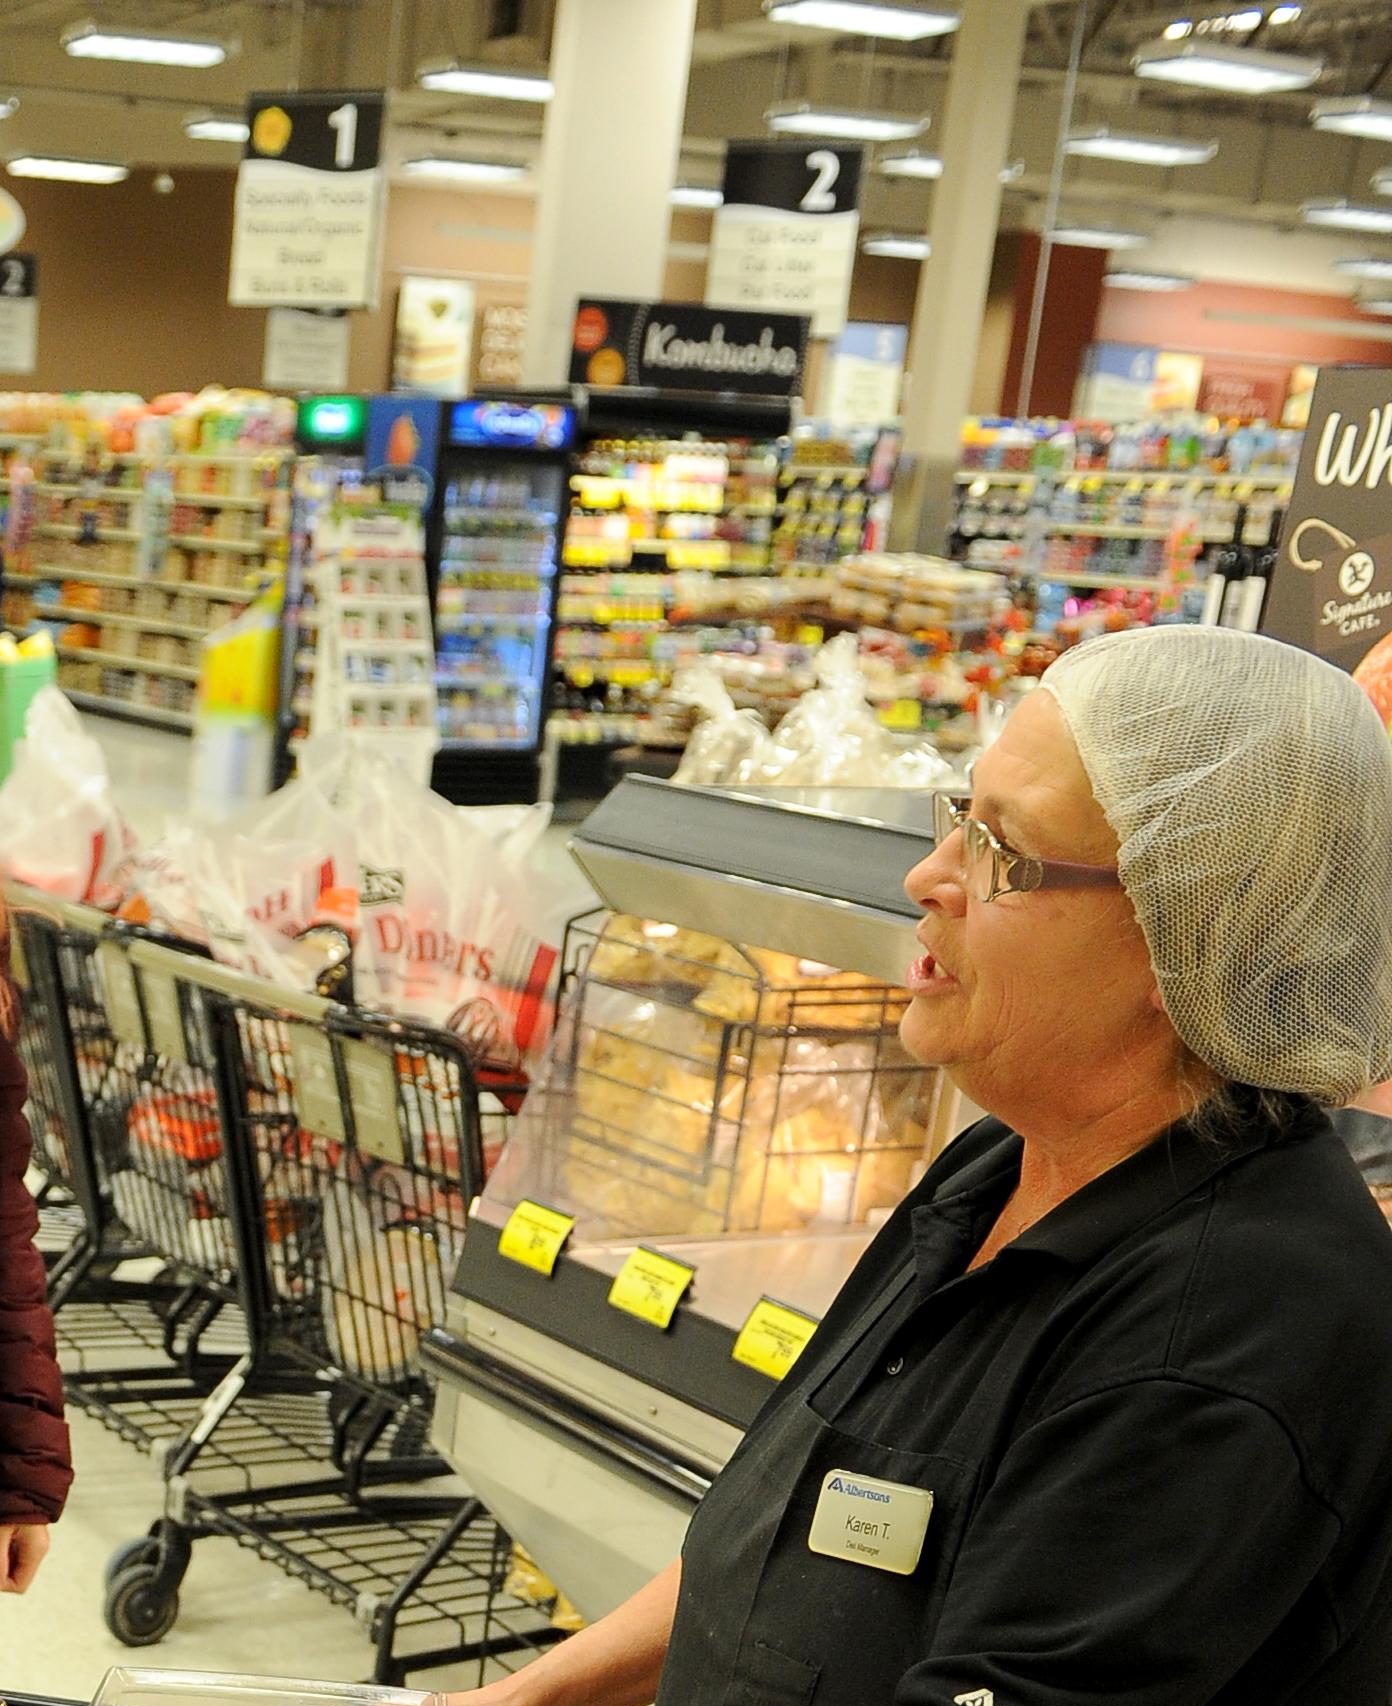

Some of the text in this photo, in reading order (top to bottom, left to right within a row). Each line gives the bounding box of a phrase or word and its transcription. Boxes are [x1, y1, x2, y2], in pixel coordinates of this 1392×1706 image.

[328, 103, 357, 168] 1
[799, 150, 840, 212] 2
[1, 259, 25, 297] 2
[643, 321, 798, 376] Kombucha
[843, 1483, 891, 1504] Albertsons
[845, 1514, 891, 1540] Karen T.
